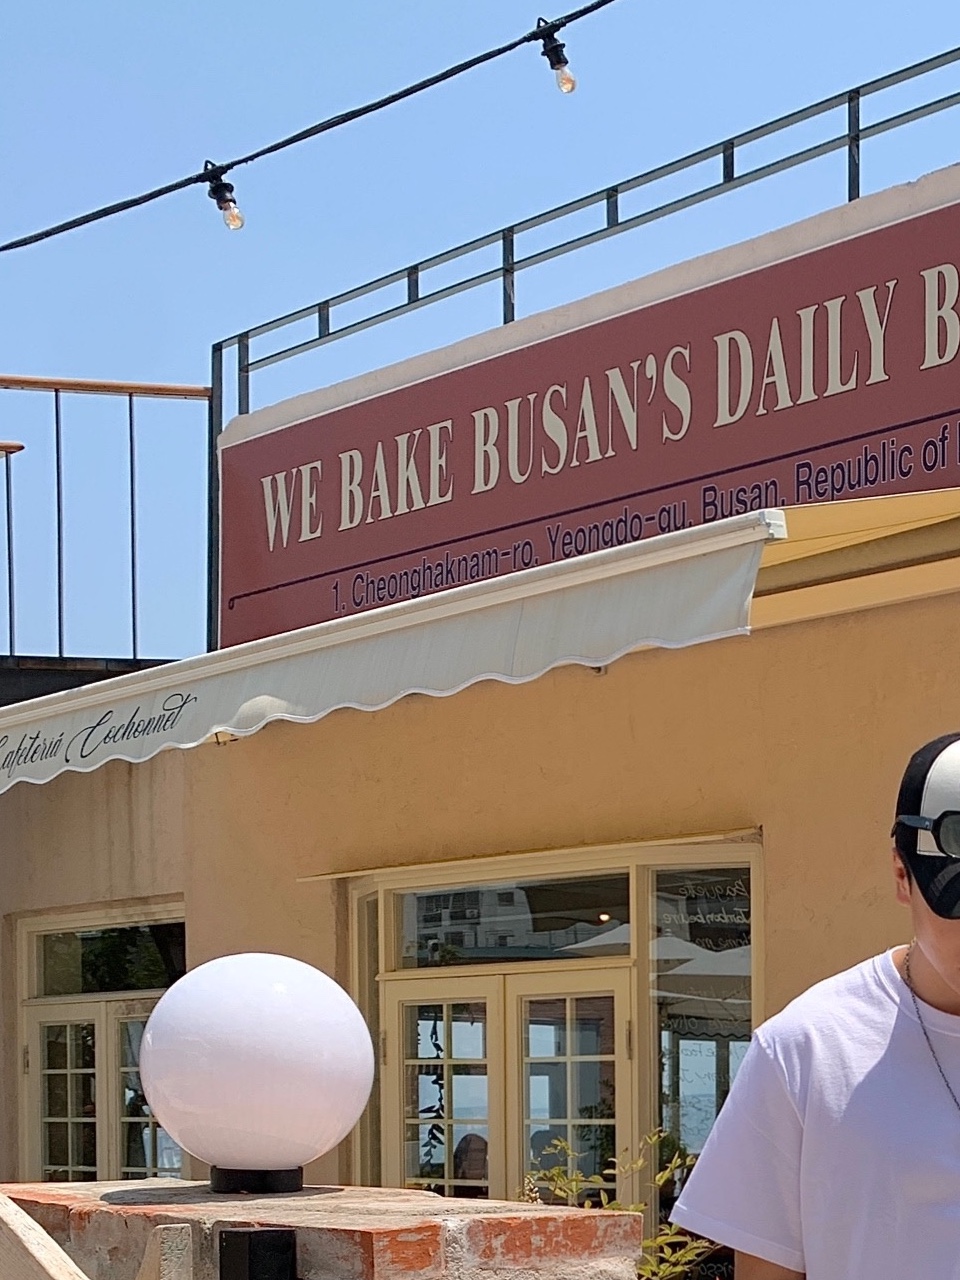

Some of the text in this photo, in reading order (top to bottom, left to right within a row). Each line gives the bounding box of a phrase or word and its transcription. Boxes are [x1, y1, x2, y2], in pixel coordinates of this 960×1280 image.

[260, 460, 323, 552] WE
[338, 420, 453, 533] BAKE
[471, 343, 692, 494] BUSAN'S
[713, 279, 898, 428] DAILY
[794, 438, 914, 504] Republic
[921, 423, 949, 474] of
[65, 693, 197, 763] Cochonnet
